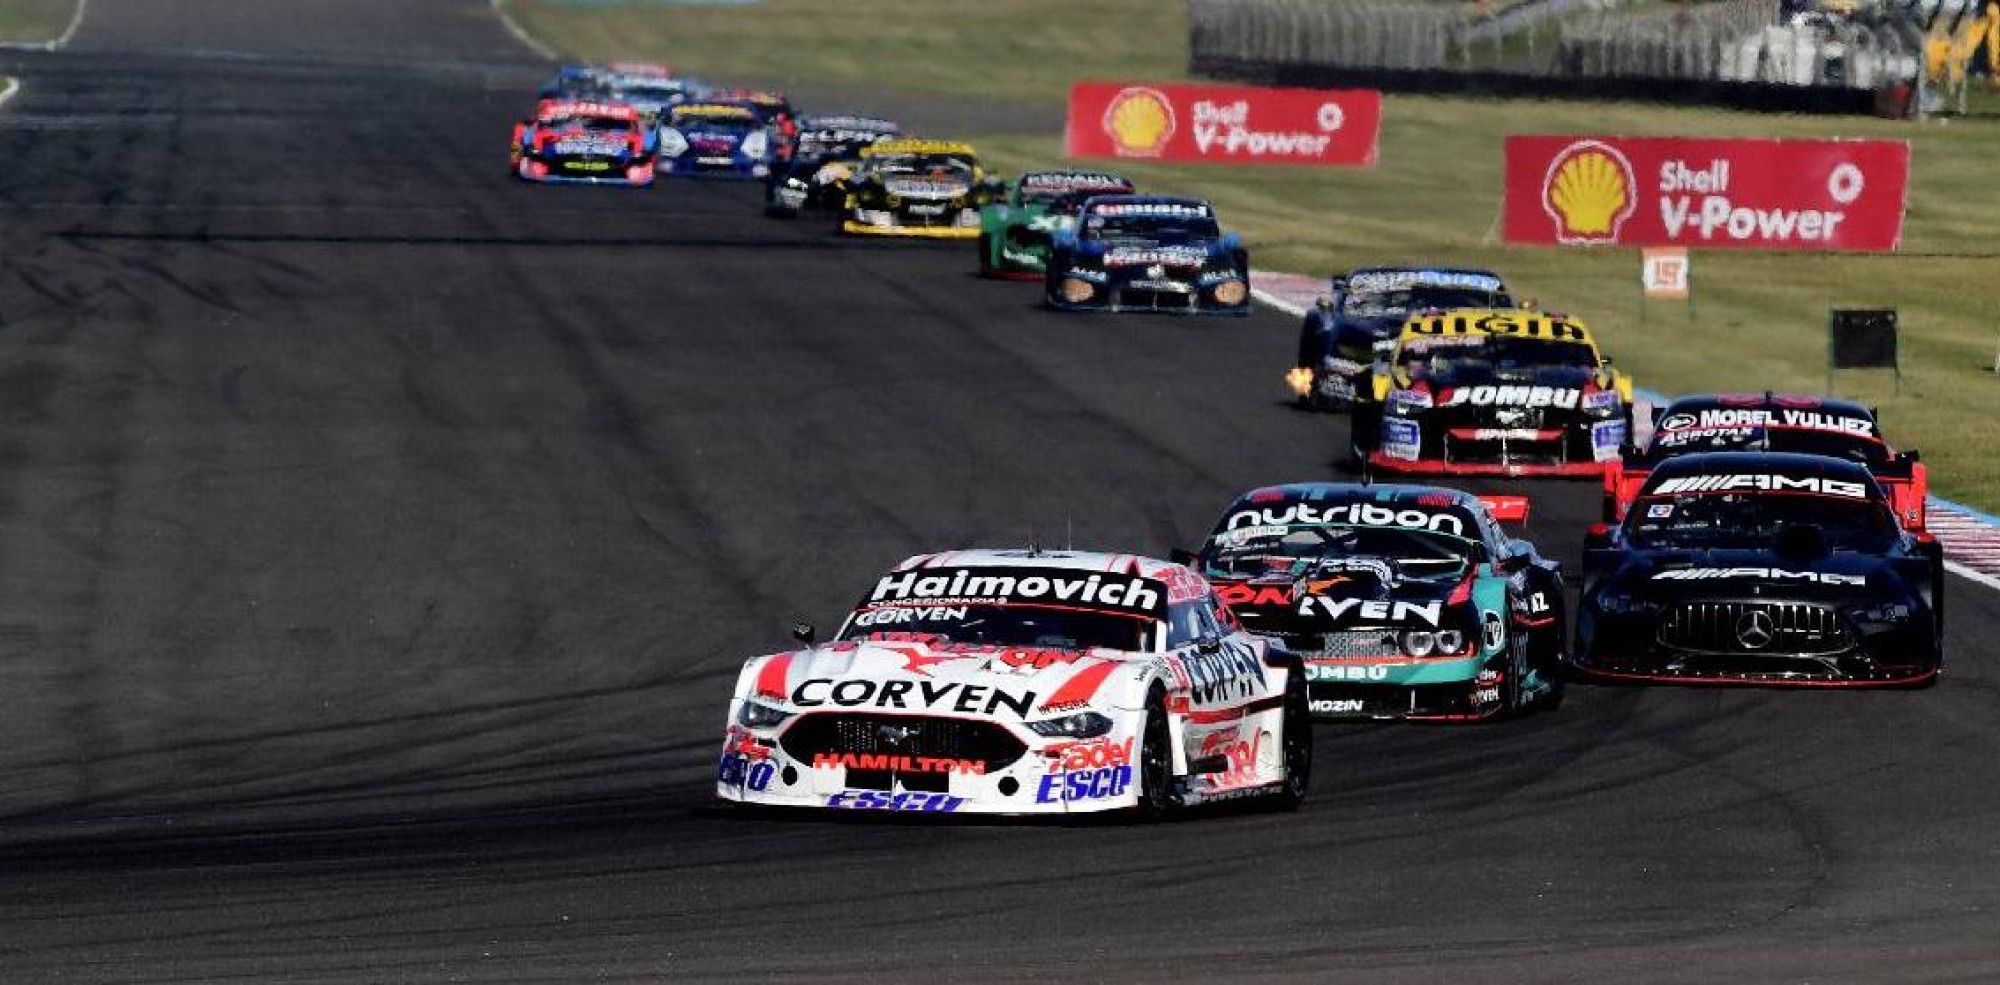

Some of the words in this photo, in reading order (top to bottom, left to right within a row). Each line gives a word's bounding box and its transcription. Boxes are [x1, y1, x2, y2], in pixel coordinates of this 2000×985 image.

[1194, 124, 1331, 153] V-Power
[1659, 159, 1730, 193] Shell
[1660, 195, 1845, 239] V-Power
[1700, 409, 1780, 429] MOREL
[1784, 410, 1873, 437] VULLIEZ
[1227, 503, 1463, 537] nutribon
[871, 569, 1158, 611] Haimovich
[855, 606, 968, 627] CORVEN
[791, 677, 1037, 720] CORVEN
[813, 751, 988, 776] HAMILTON
[1035, 765, 1132, 804] ESCO
